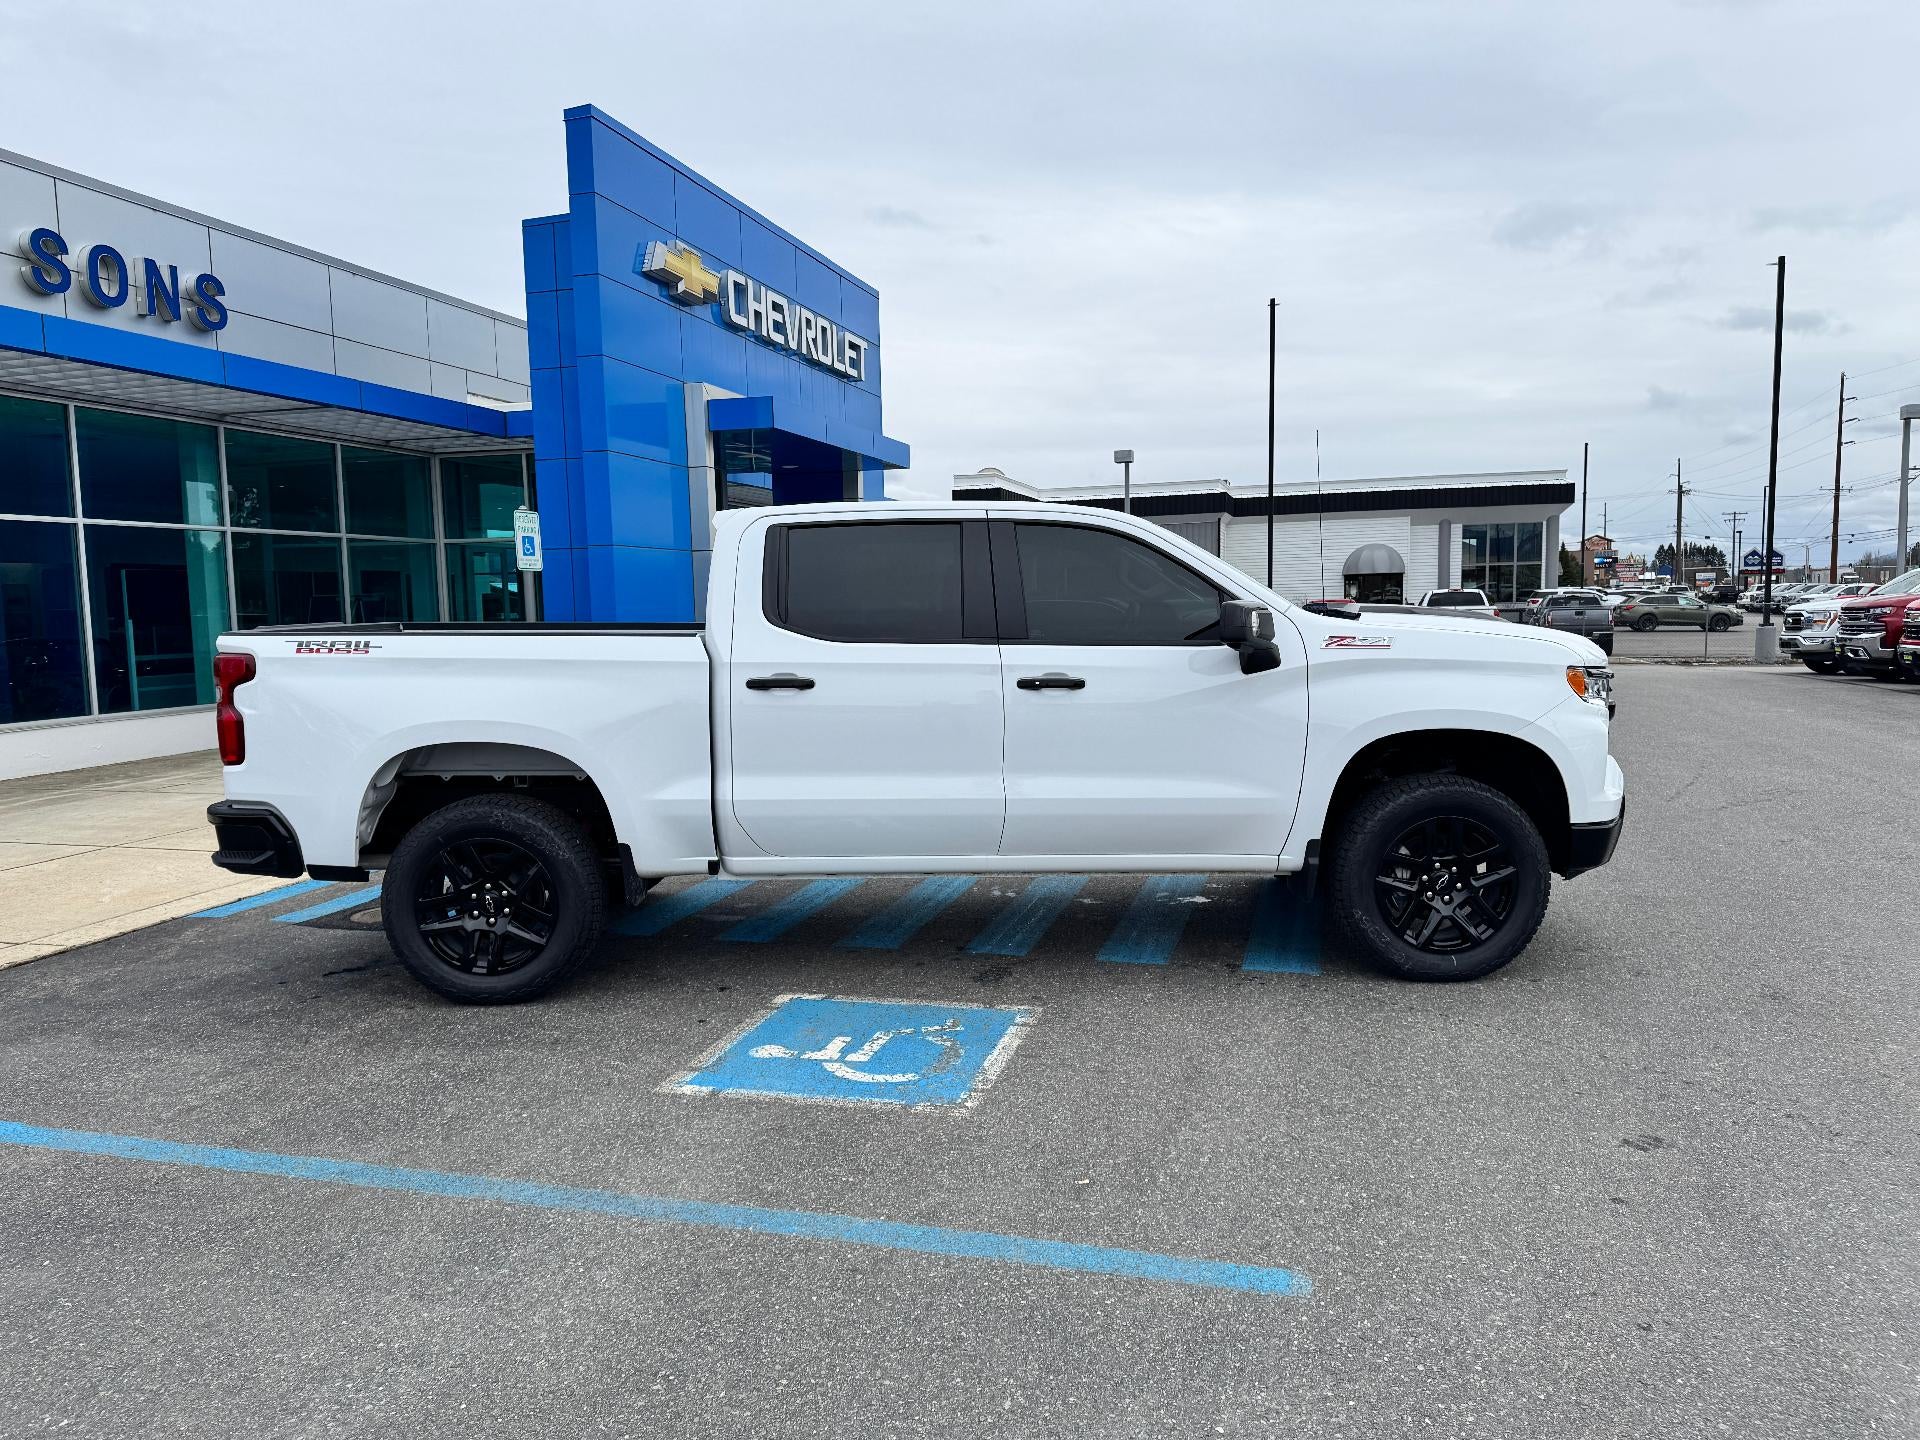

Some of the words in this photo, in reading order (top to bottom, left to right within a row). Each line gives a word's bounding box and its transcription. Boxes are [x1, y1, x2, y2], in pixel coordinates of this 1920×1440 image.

[20, 228, 228, 331] SONS
[720, 269, 868, 382] CHEVROLET
[517, 525, 537, 534] PARKING
[285, 640, 382, 649] TRAIL
